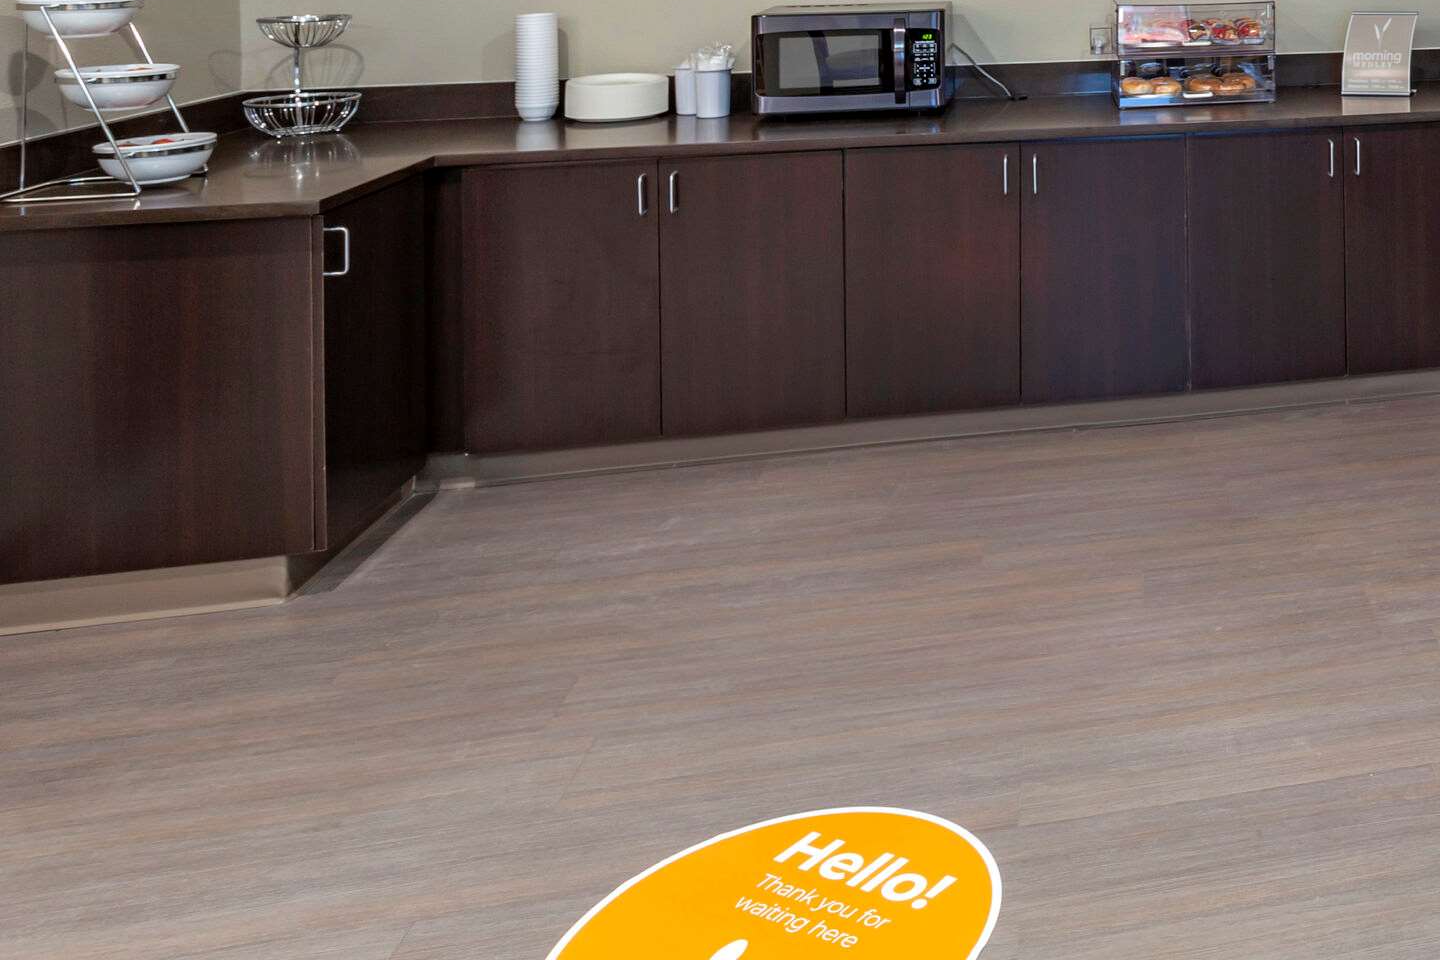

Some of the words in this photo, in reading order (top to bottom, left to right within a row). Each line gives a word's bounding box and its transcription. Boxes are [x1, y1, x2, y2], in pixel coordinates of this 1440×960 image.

[1352, 50, 1402, 65] morning
[773, 831, 958, 910] Hello!
[735, 896, 810, 933] waiting
[807, 920, 858, 948] here
[756, 873, 819, 905] Thank
[809, 897, 858, 919] you
[856, 908, 892, 929] for
